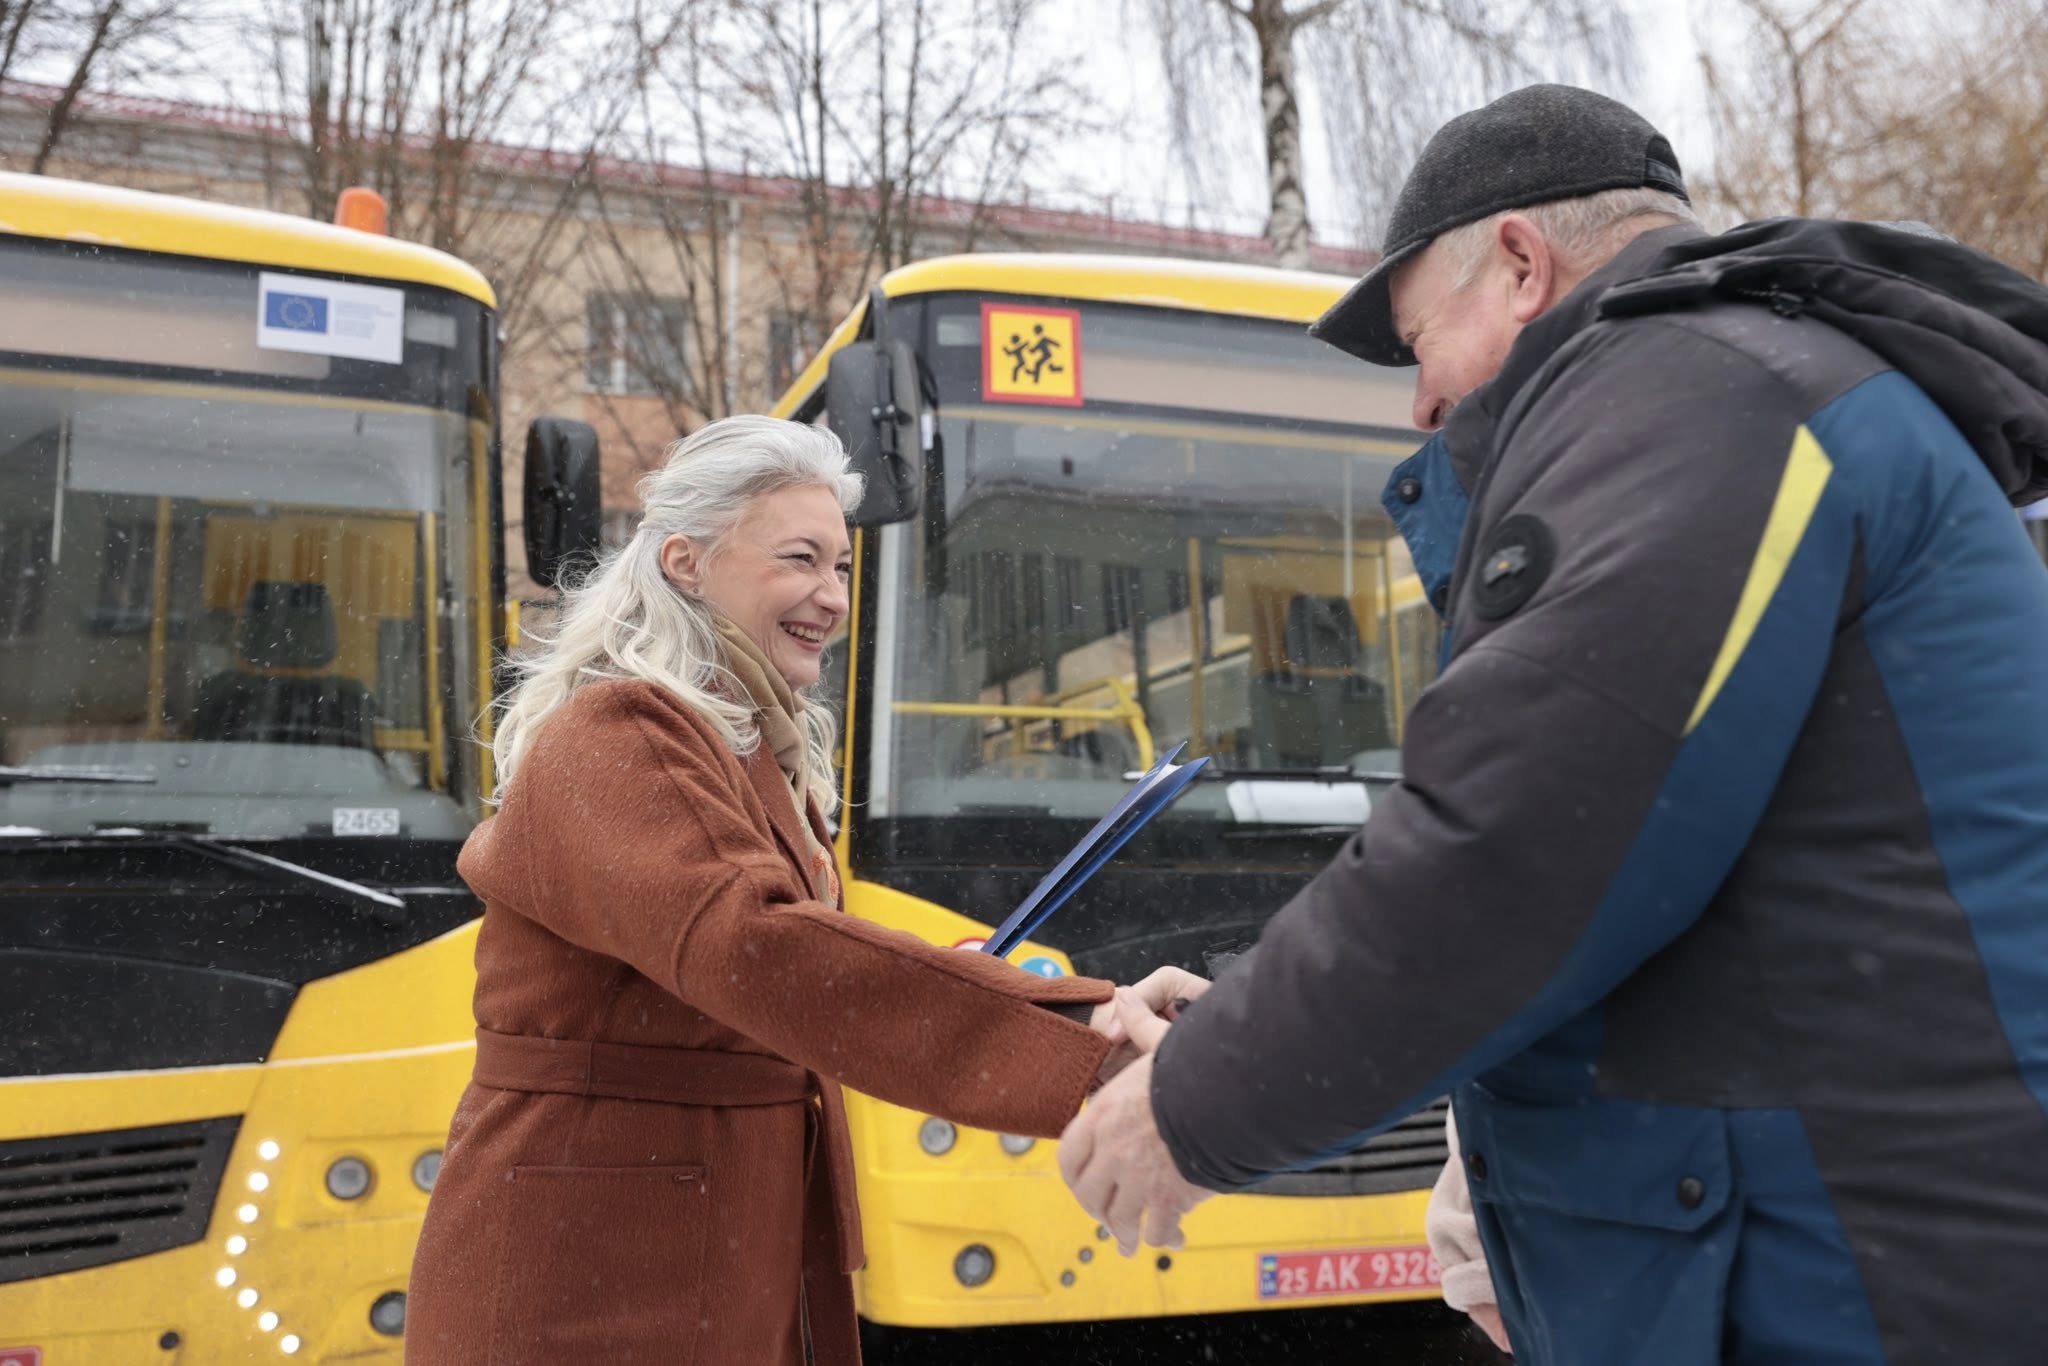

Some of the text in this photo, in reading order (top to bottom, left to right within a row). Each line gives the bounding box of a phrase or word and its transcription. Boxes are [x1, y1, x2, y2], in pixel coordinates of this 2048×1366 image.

[337, 810, 396, 832] 2465
[1279, 1267, 1309, 1294] 25
[1315, 1255, 1362, 1290] AK
